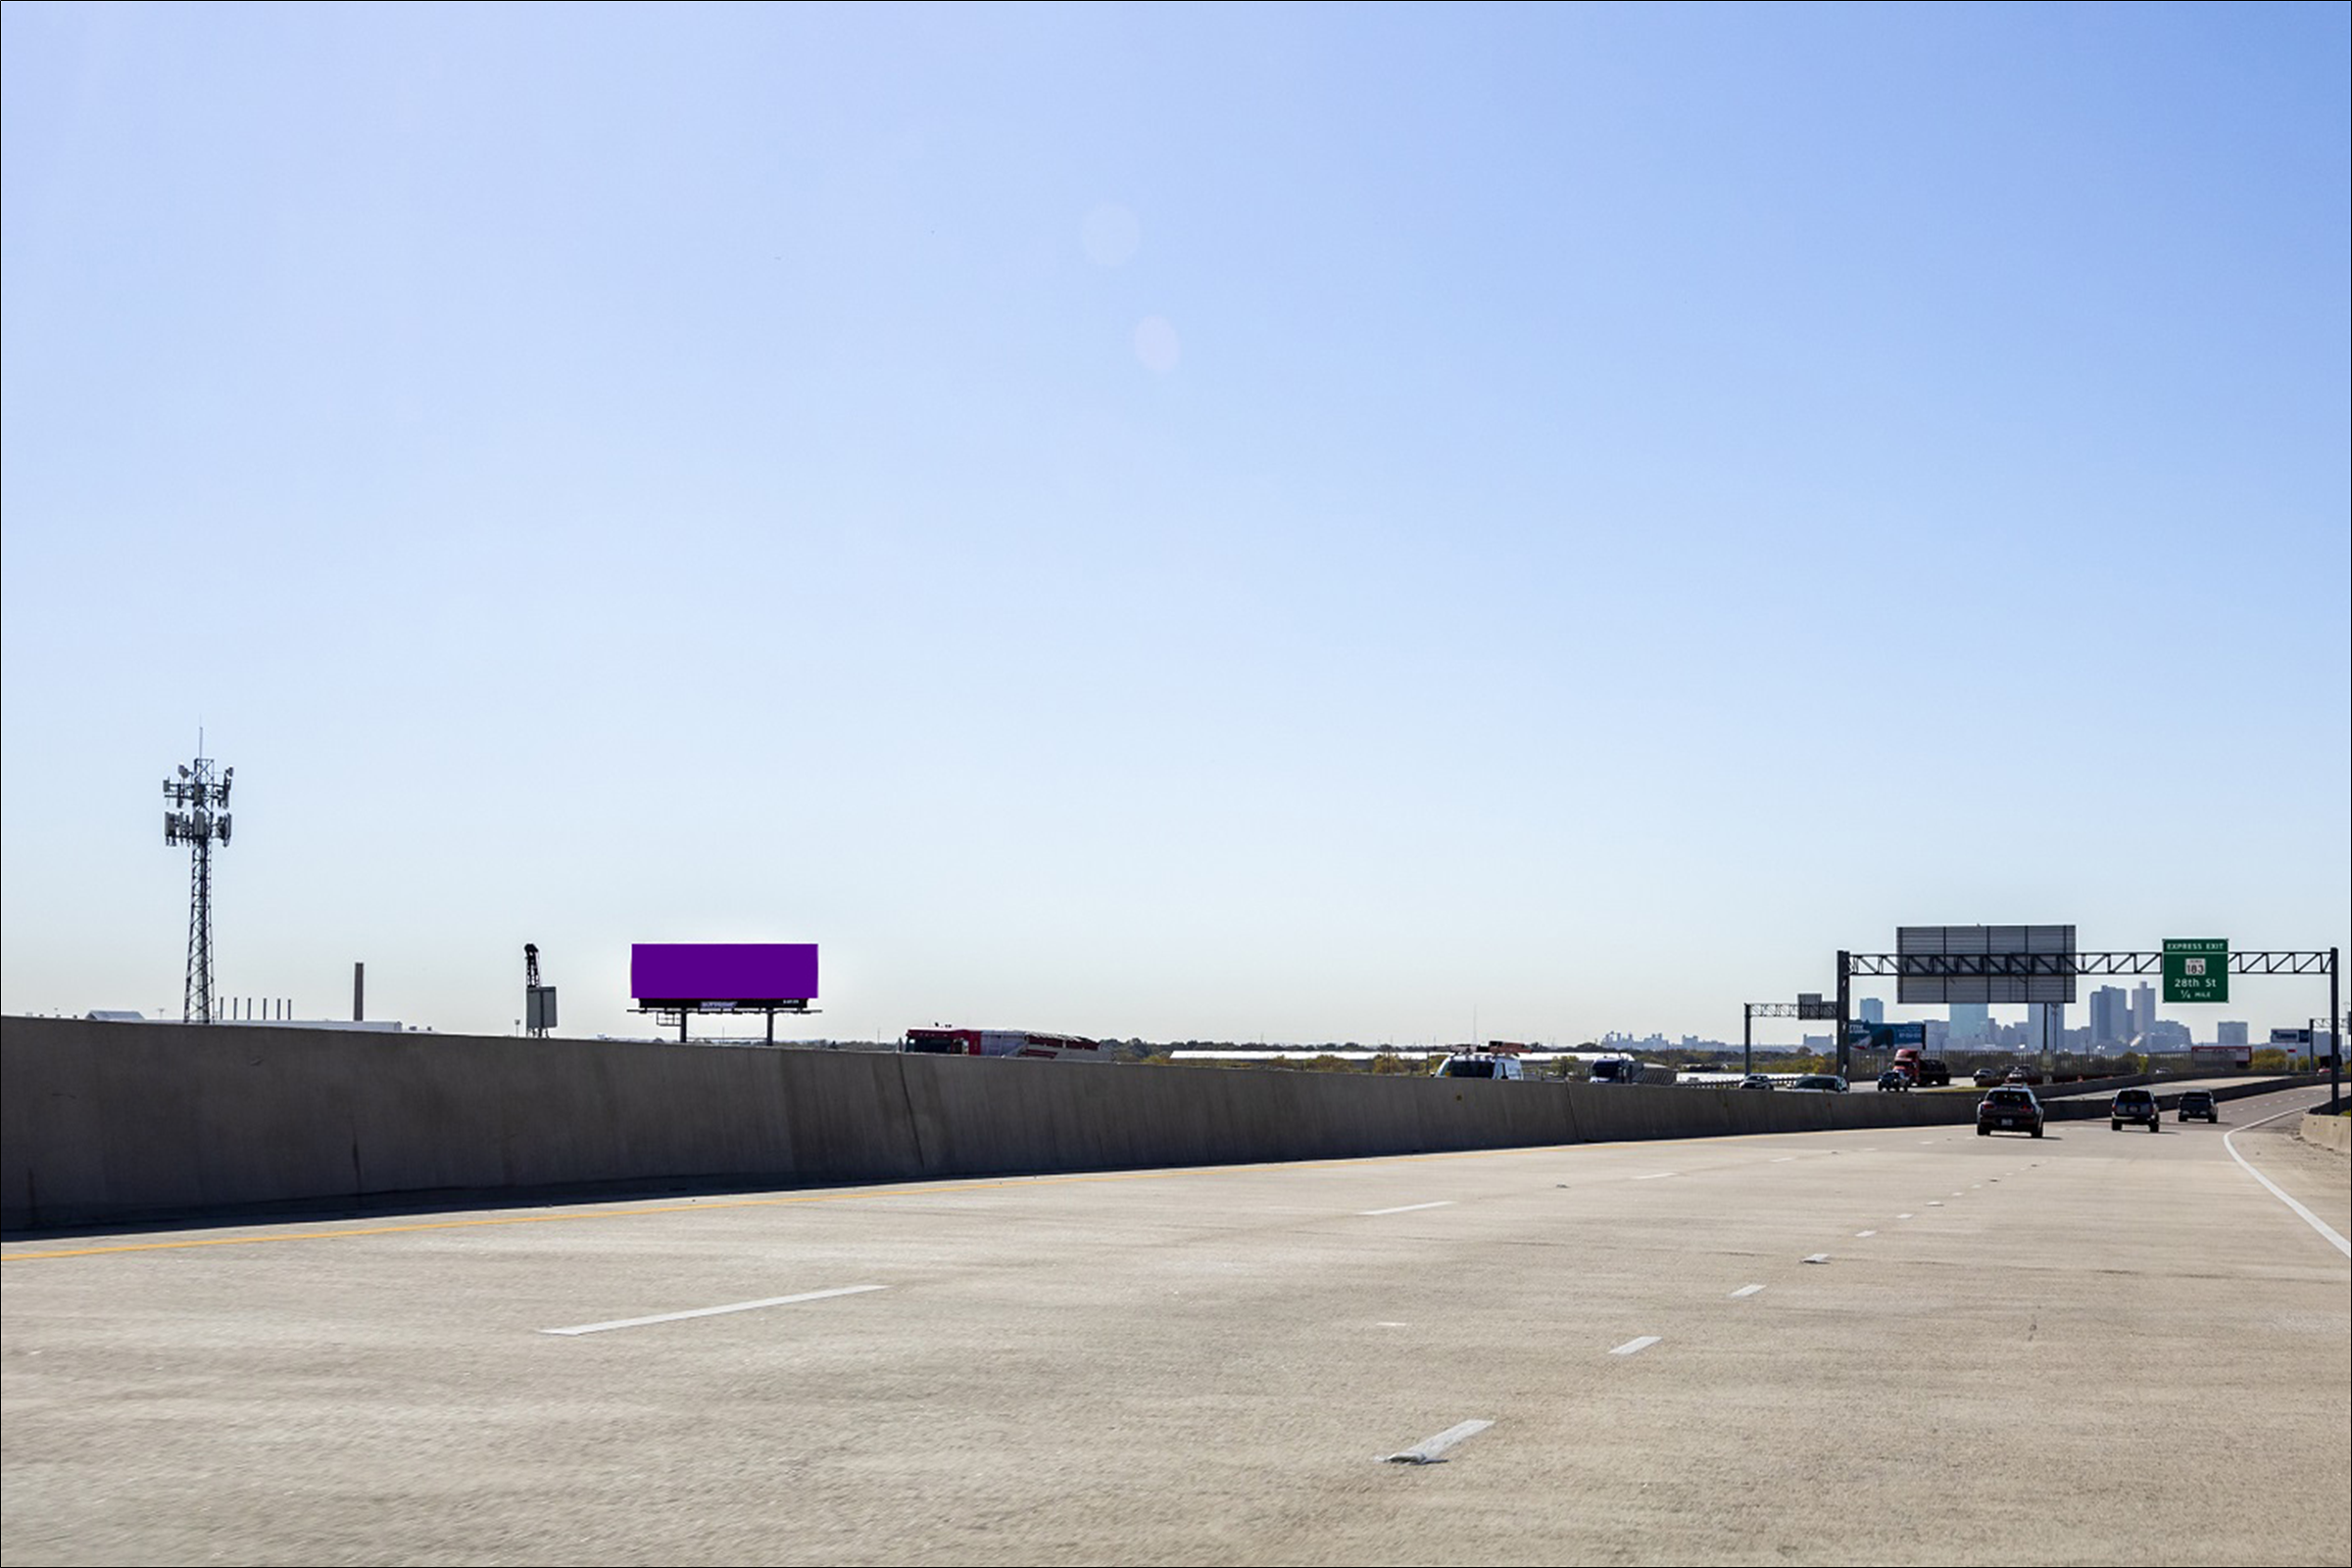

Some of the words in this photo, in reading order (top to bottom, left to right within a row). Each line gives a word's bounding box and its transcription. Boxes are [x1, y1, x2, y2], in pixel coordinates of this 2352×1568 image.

[2187, 964, 2204, 974] 183
[2175, 978, 2200, 988] 28th
[2205, 978, 2217, 988] St
